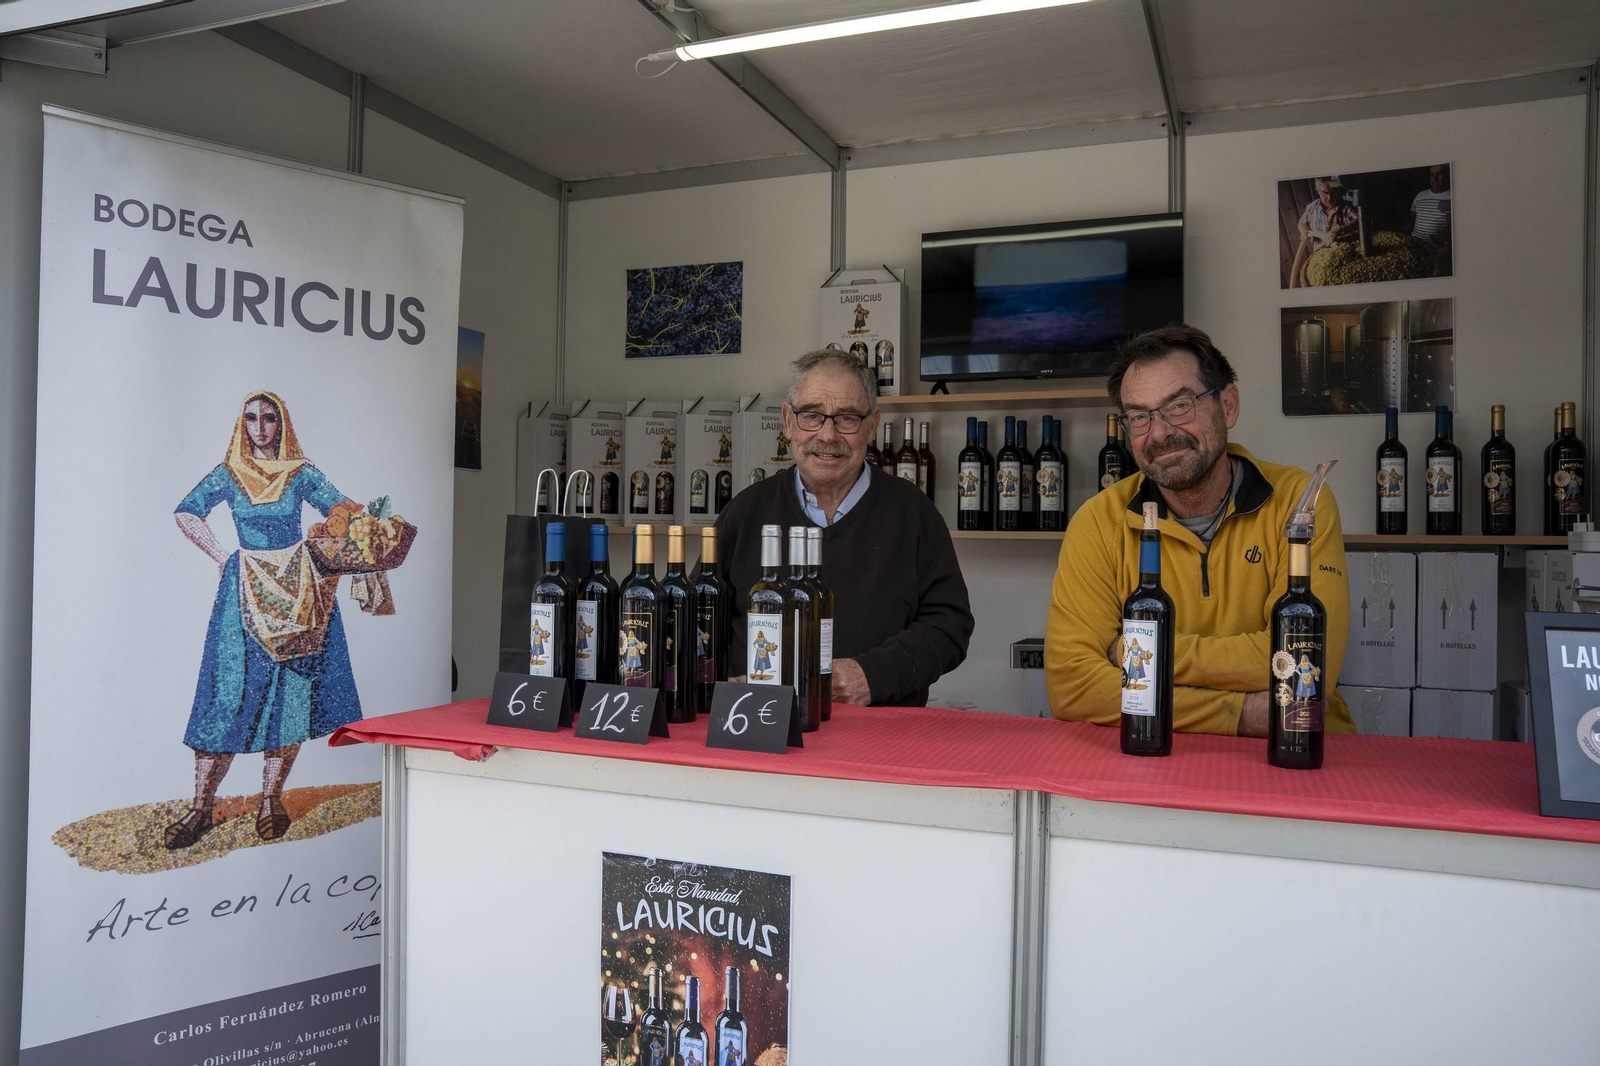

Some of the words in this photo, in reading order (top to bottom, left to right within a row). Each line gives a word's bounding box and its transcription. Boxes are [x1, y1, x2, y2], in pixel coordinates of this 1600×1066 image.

[94, 193, 253, 248] BODEGA
[92, 248, 426, 345] LAURICIUS
[840, 294, 882, 304] LAURICIUS
[507, 682, 528, 716] 6
[533, 691, 547, 711] €
[1585, 673, 1600, 691] N
[590, 692, 629, 733] 12
[630, 705, 644, 722] €
[723, 692, 753, 735] 6
[758, 700, 777, 725] €
[86, 897, 190, 943] Arte
[210, 893, 258, 918] en
[275, 873, 311, 907] la
[645, 876, 674, 897] Esta
[676, 880, 743, 905] Navidad,
[616, 899, 779, 957] LAURICIUS
[153, 1021, 212, 1046] Carlos
[219, 1000, 304, 1030] Fernández
[310, 984, 367, 1007] Romero
[203, 1047, 260, 1066] Olivillas
[264, 1040, 282, 1053] s/n
[295, 1022, 351, 1044] Abrucena
[250, 1037, 349, 1066] ricius@yahoo.es
